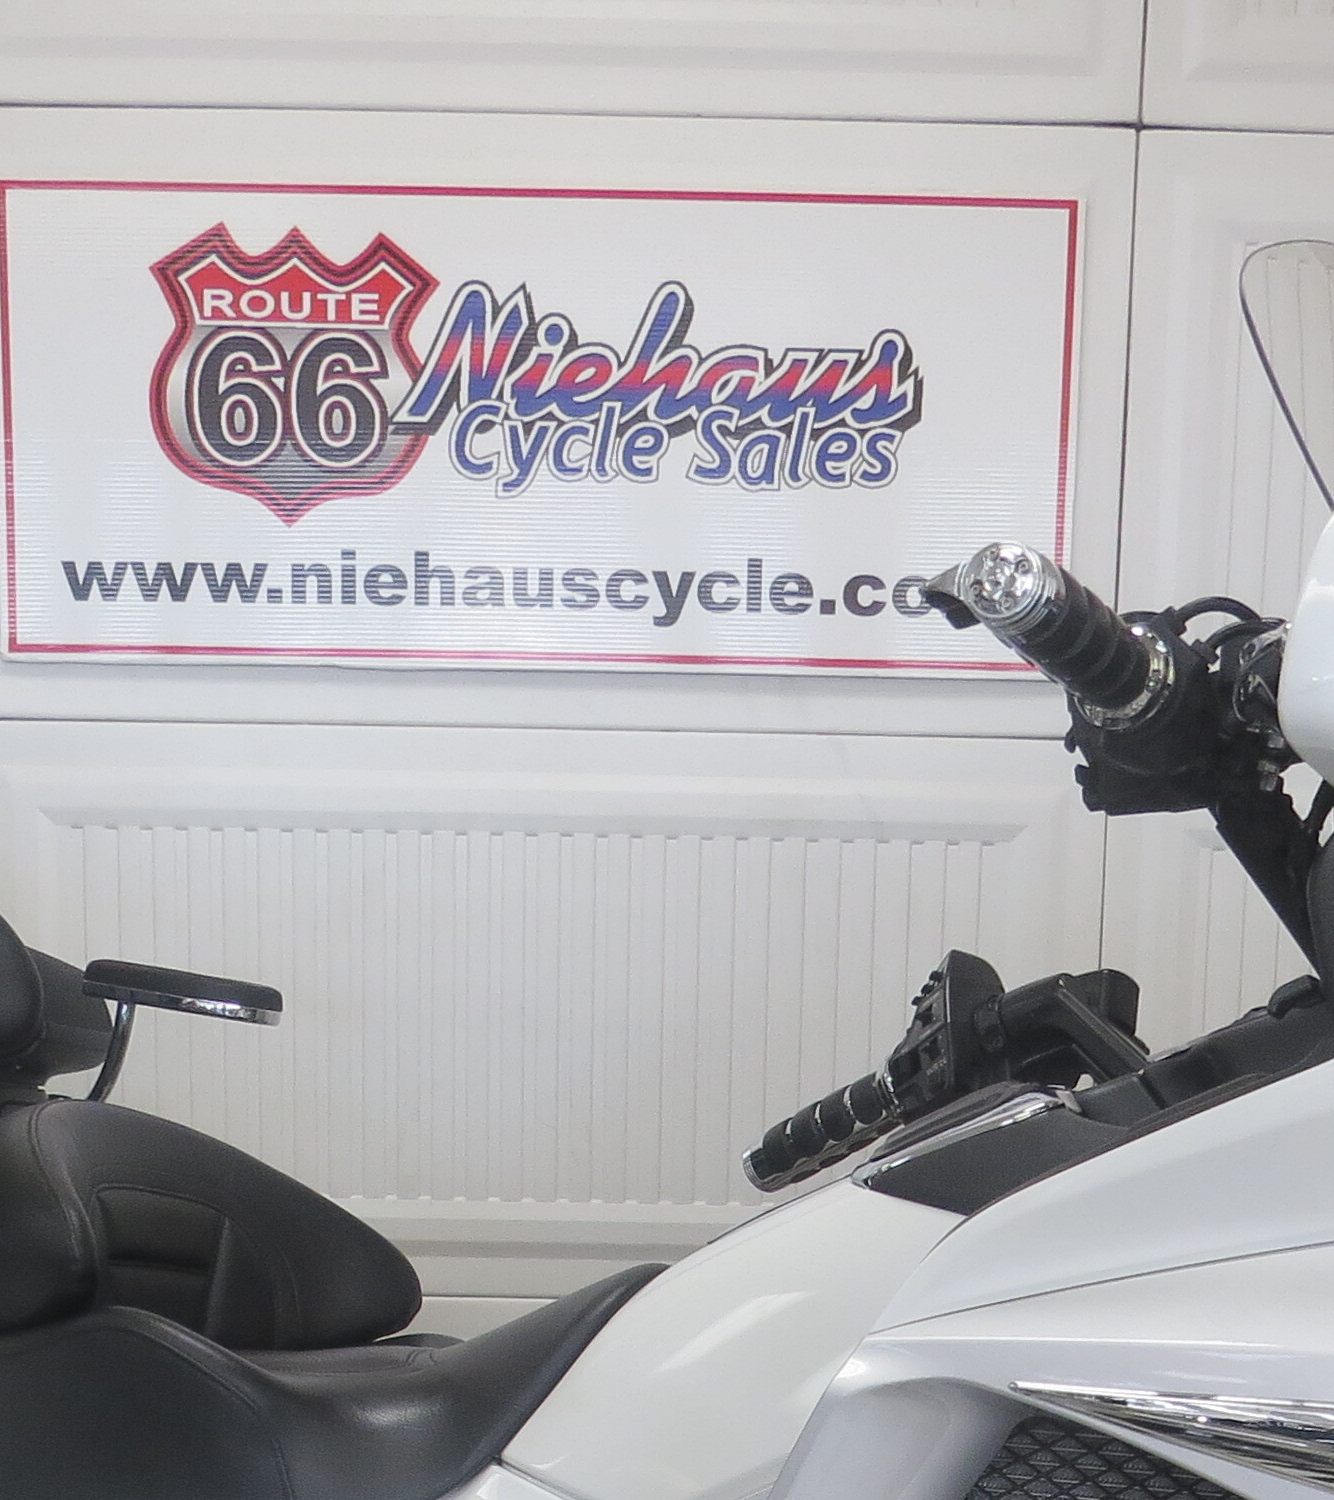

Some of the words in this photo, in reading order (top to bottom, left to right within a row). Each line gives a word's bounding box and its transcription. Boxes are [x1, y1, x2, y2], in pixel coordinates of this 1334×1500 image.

[202, 288, 381, 322] ROUTE
[187, 328, 388, 468] 66
[390, 280, 921, 430] Niehaus
[448, 400, 670, 498] Cycle
[686, 402, 902, 491] Sales
[60, 549, 935, 628] www.niehauscycle.co
